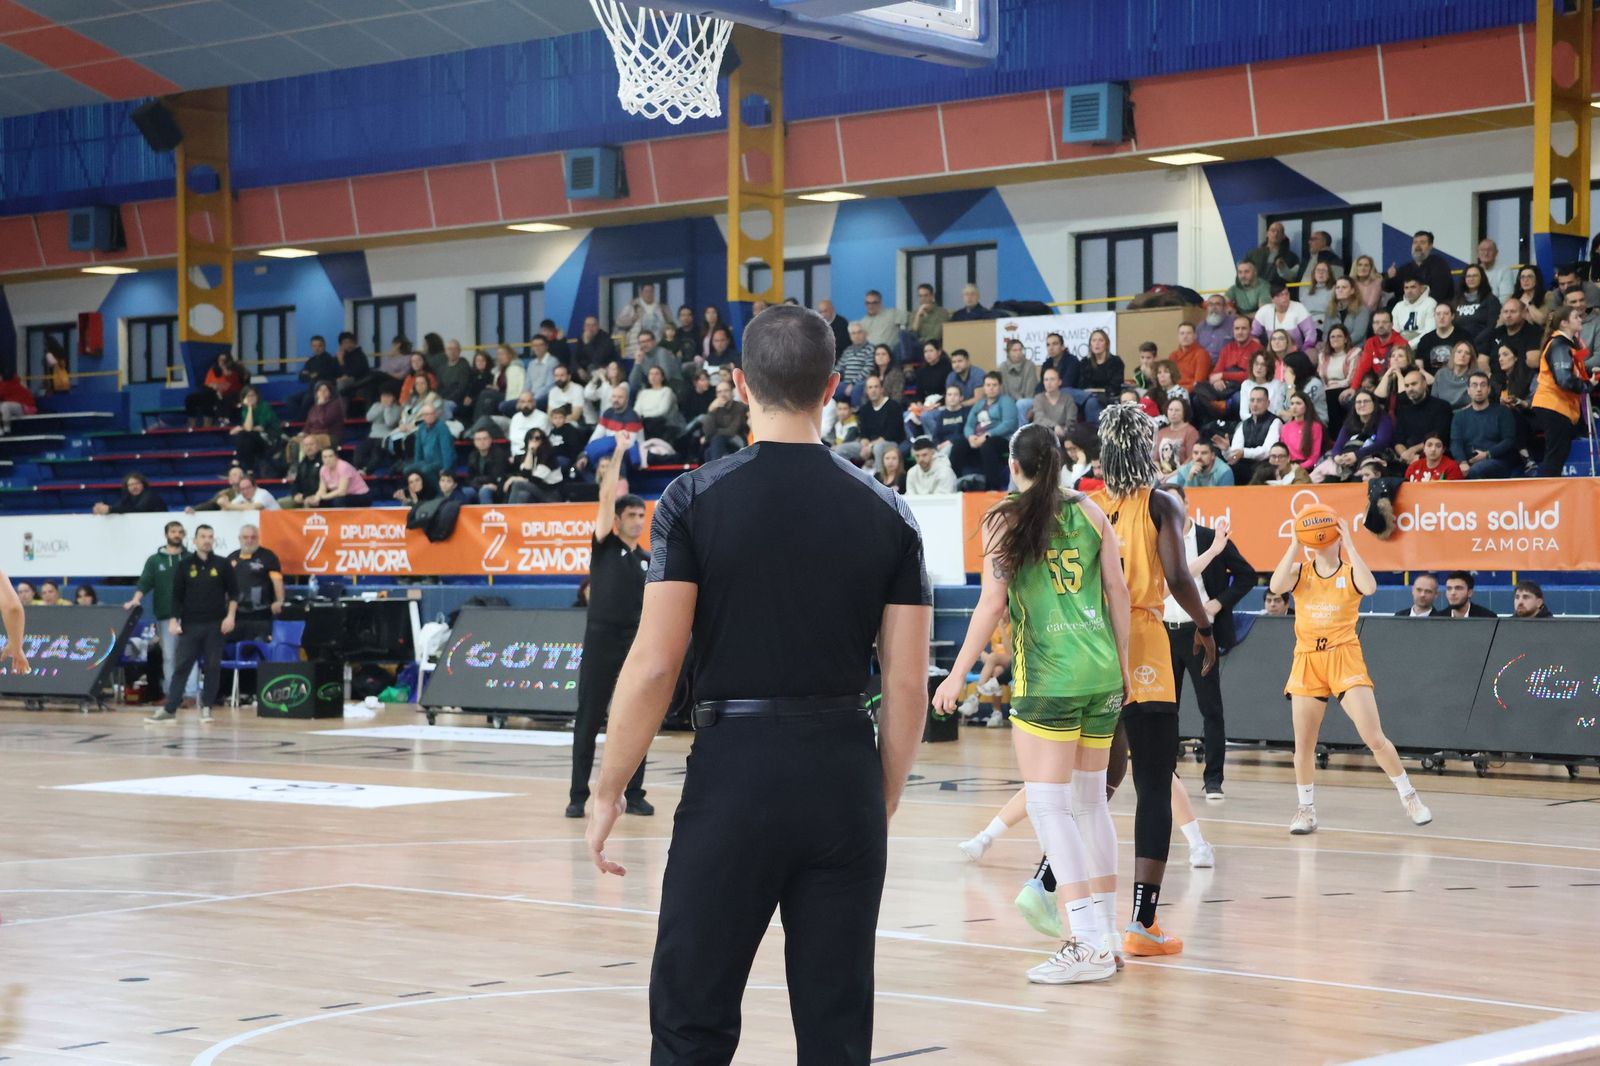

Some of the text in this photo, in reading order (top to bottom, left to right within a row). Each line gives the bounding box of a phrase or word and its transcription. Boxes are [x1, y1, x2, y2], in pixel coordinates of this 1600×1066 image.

[1302, 516, 1333, 528] Wilson
[1353, 501, 1560, 532] roletas salud
[1471, 538, 1560, 552] ZAMORA
[335, 549, 412, 573] ZAMORA
[517, 547, 592, 572] ZAMOR
[1045, 548, 1083, 595] 55
[1315, 637, 1328, 651] 13
